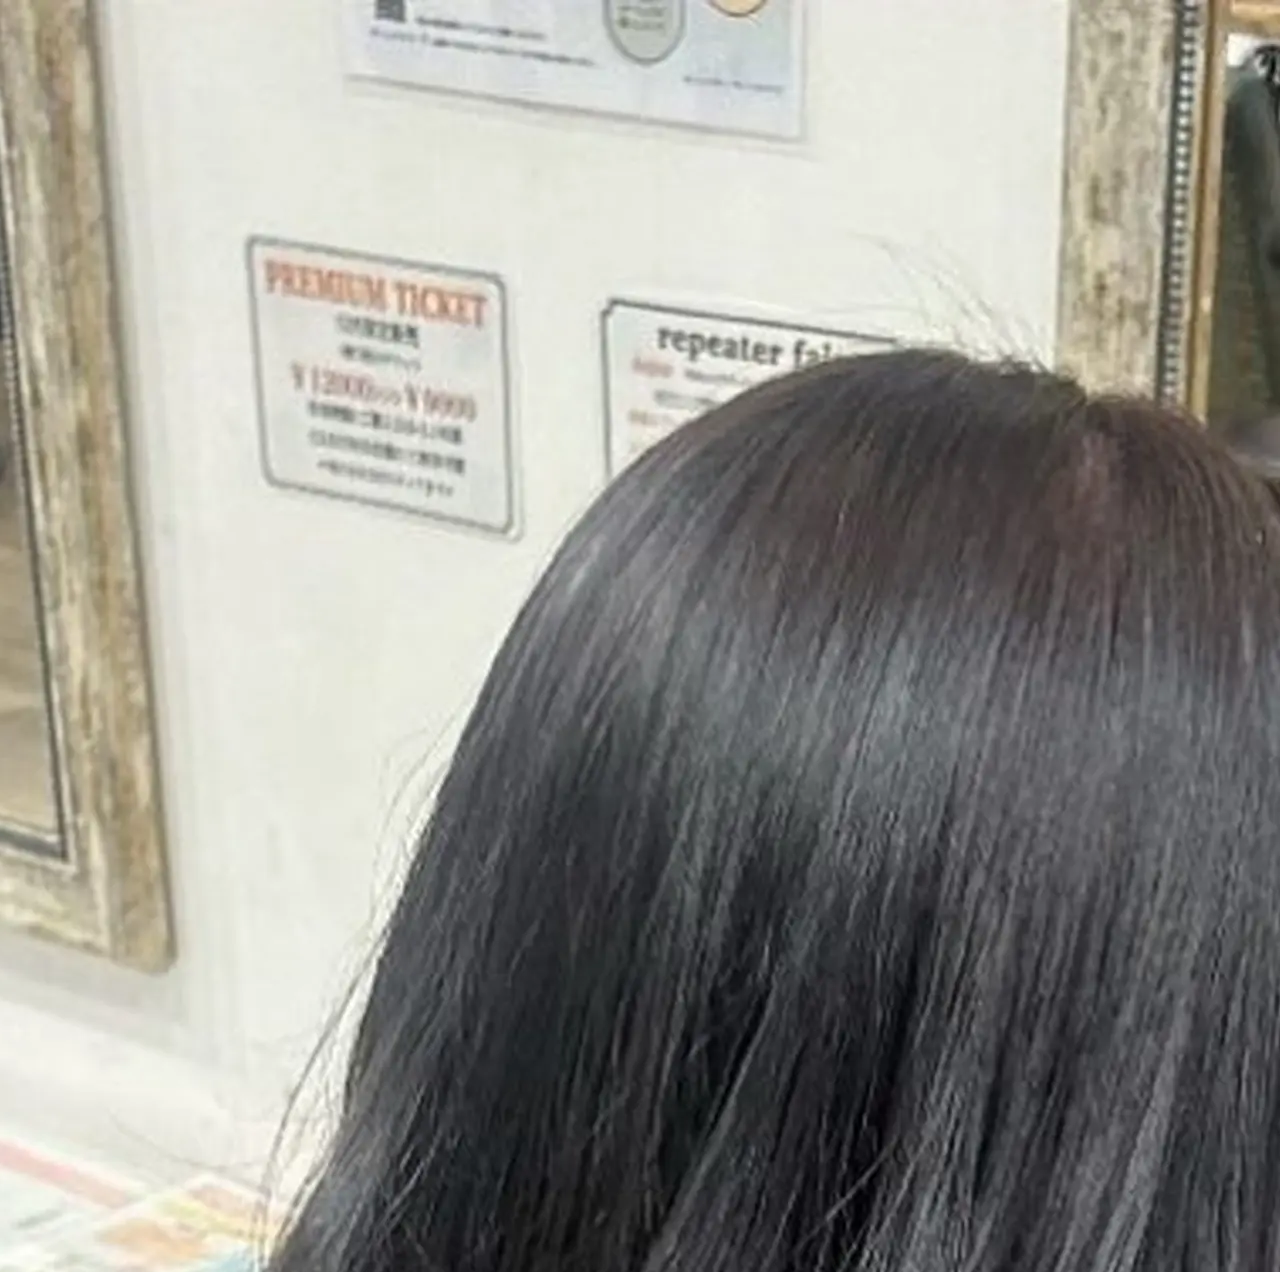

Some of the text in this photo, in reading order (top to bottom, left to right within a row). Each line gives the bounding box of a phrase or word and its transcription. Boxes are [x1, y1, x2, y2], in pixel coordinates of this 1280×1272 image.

[264, 258, 489, 328] PREMIUM TICKET
[656, 326, 833, 369] repeater fai
